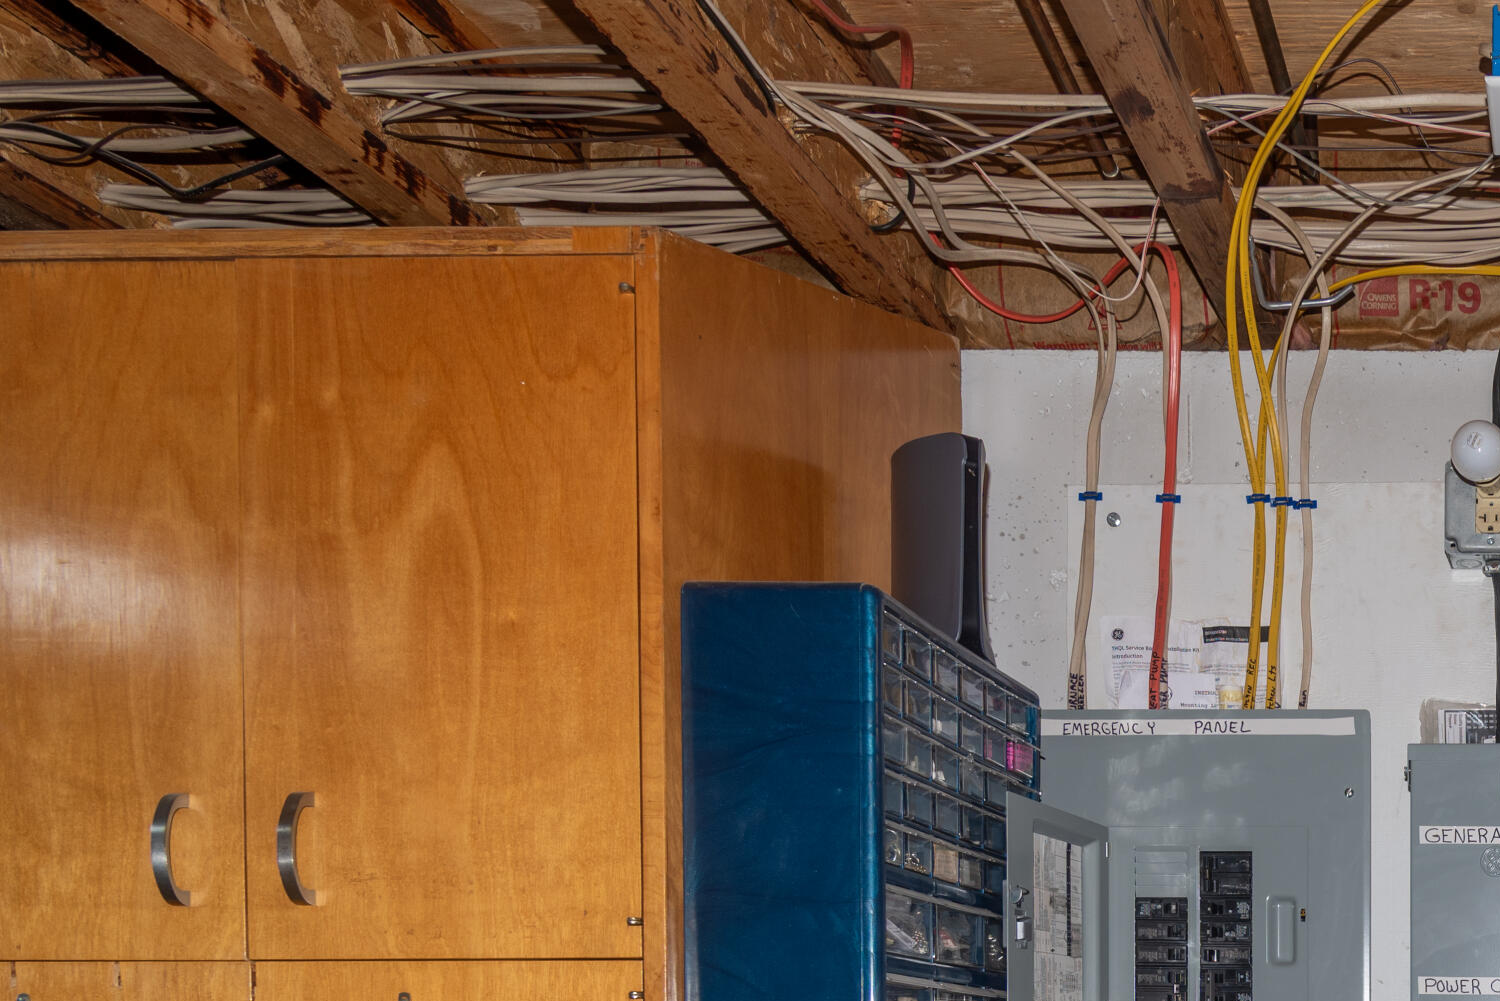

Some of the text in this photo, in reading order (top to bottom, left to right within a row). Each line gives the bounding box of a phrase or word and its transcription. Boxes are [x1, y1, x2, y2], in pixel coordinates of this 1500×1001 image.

[1367, 293, 1397, 302] OWENS
[1409, 279, 1482, 314] R-19
[1361, 302, 1397, 310] CORNING
[1247, 658, 1257, 675] REC
[1149, 651, 1160, 710] EAT PUMP
[1069, 672, 1078, 710] URNACE
[1063, 720, 1252, 736] EMERGENCY PANEL
[1424, 978, 1482, 995] POWER
